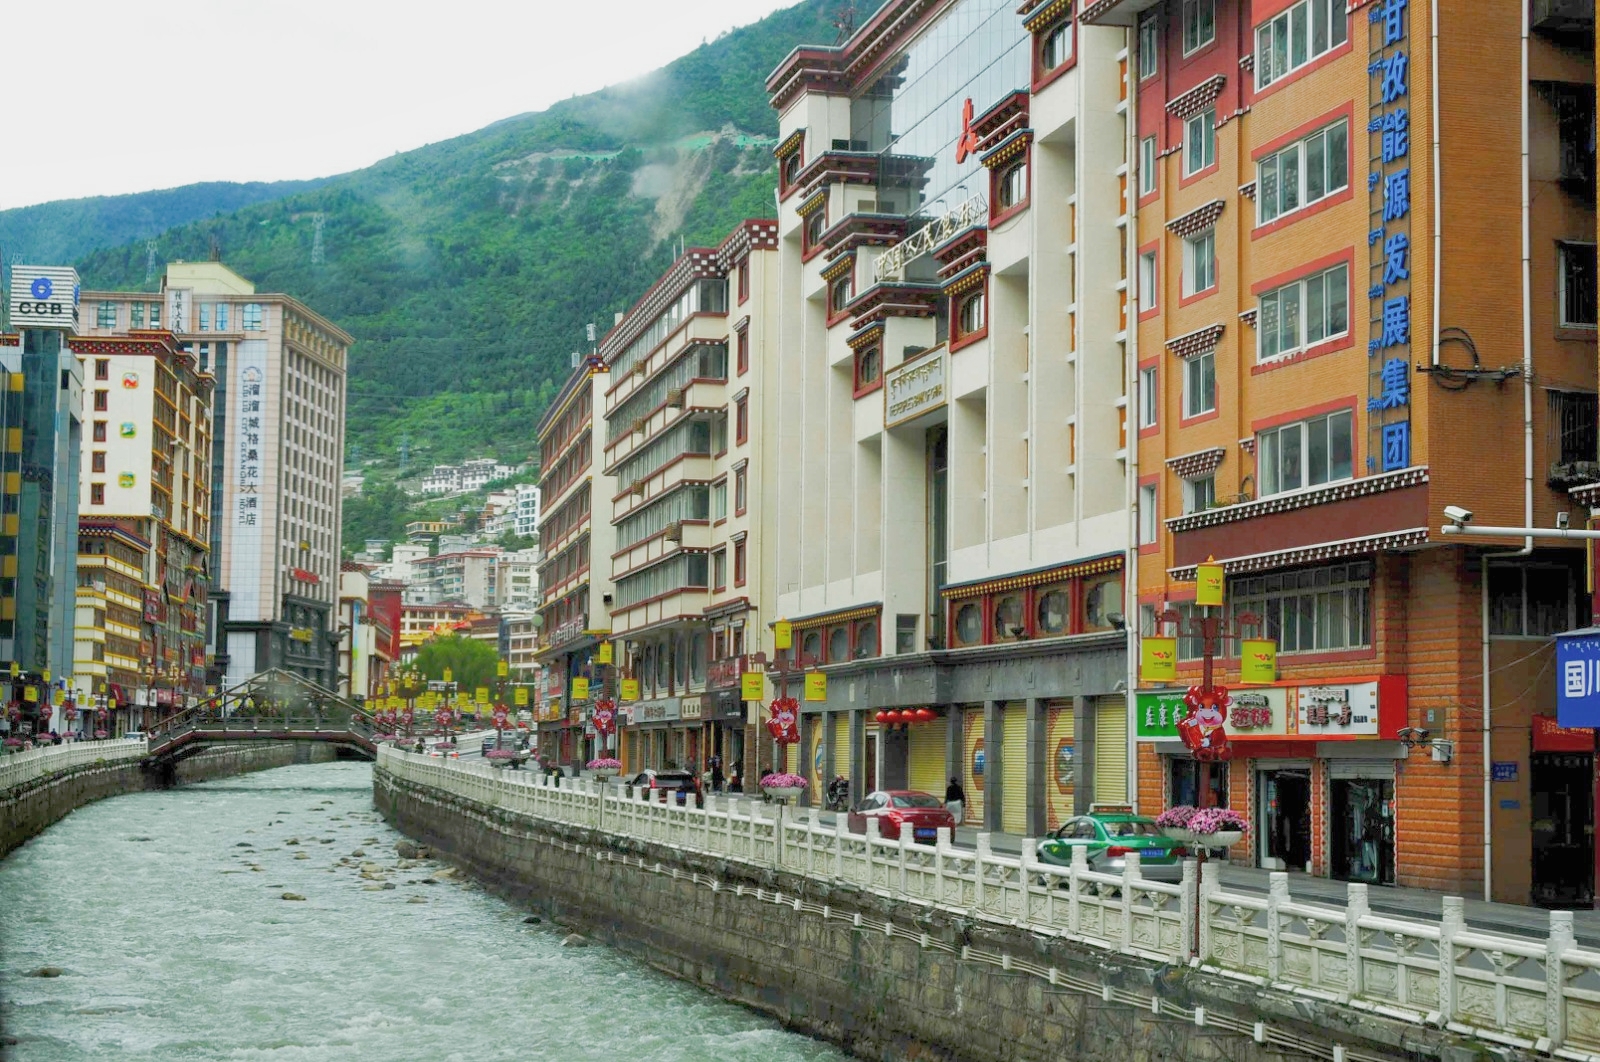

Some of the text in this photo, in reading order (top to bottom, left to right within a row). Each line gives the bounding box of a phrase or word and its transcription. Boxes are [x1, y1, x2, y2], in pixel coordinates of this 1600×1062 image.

[1380, 0, 1409, 471] 甘孜能源发展集团
[19, 301, 62, 315] CCB
[246, 383, 260, 527] 溜溜城格桑花大酒店
